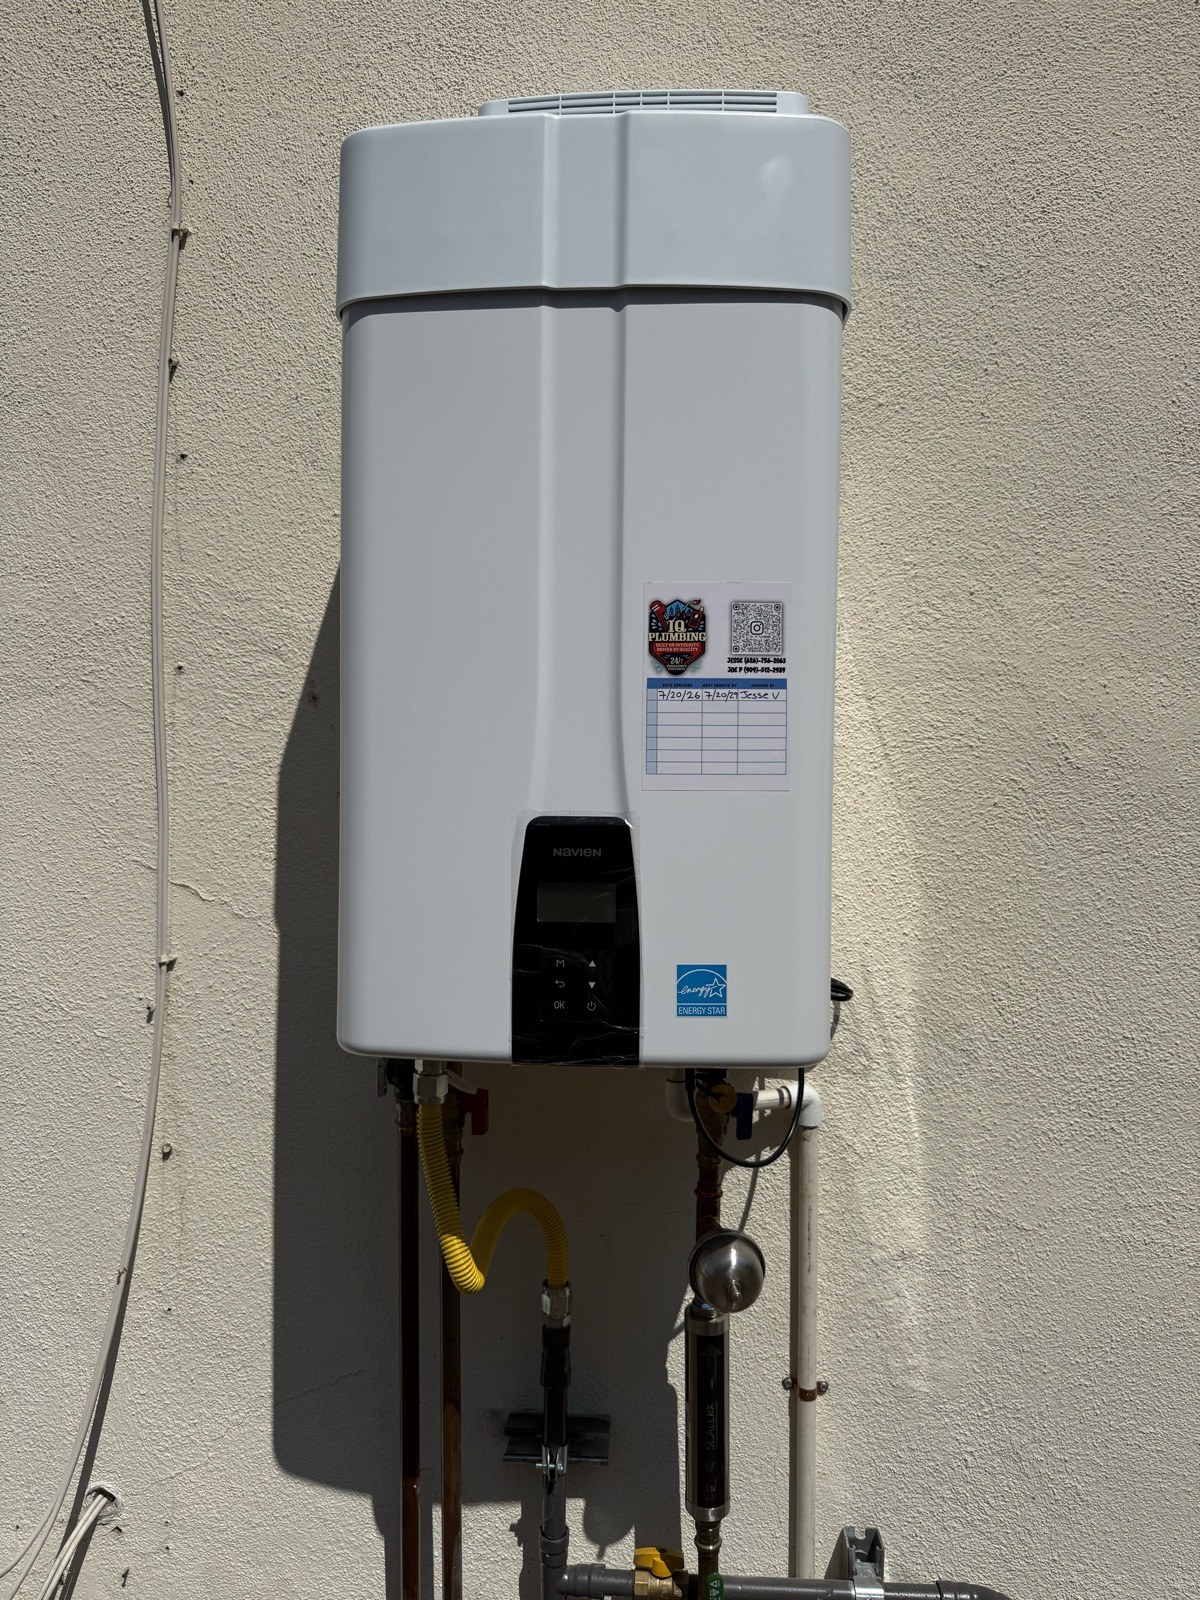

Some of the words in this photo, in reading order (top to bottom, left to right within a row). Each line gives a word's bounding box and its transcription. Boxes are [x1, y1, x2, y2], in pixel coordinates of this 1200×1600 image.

[668, 620, 686, 633] IQ
[648, 632, 707, 642] PLUMBING
[658, 690, 700, 702] 7/20/26
[740, 691, 769, 699] Jesse
[772, 692, 780, 700] V
[679, 985, 714, 998] energy
[554, 1000, 566, 1009] OK
[678, 1006, 707, 1015] ENERGY
[707, 1006, 726, 1015] STAR
